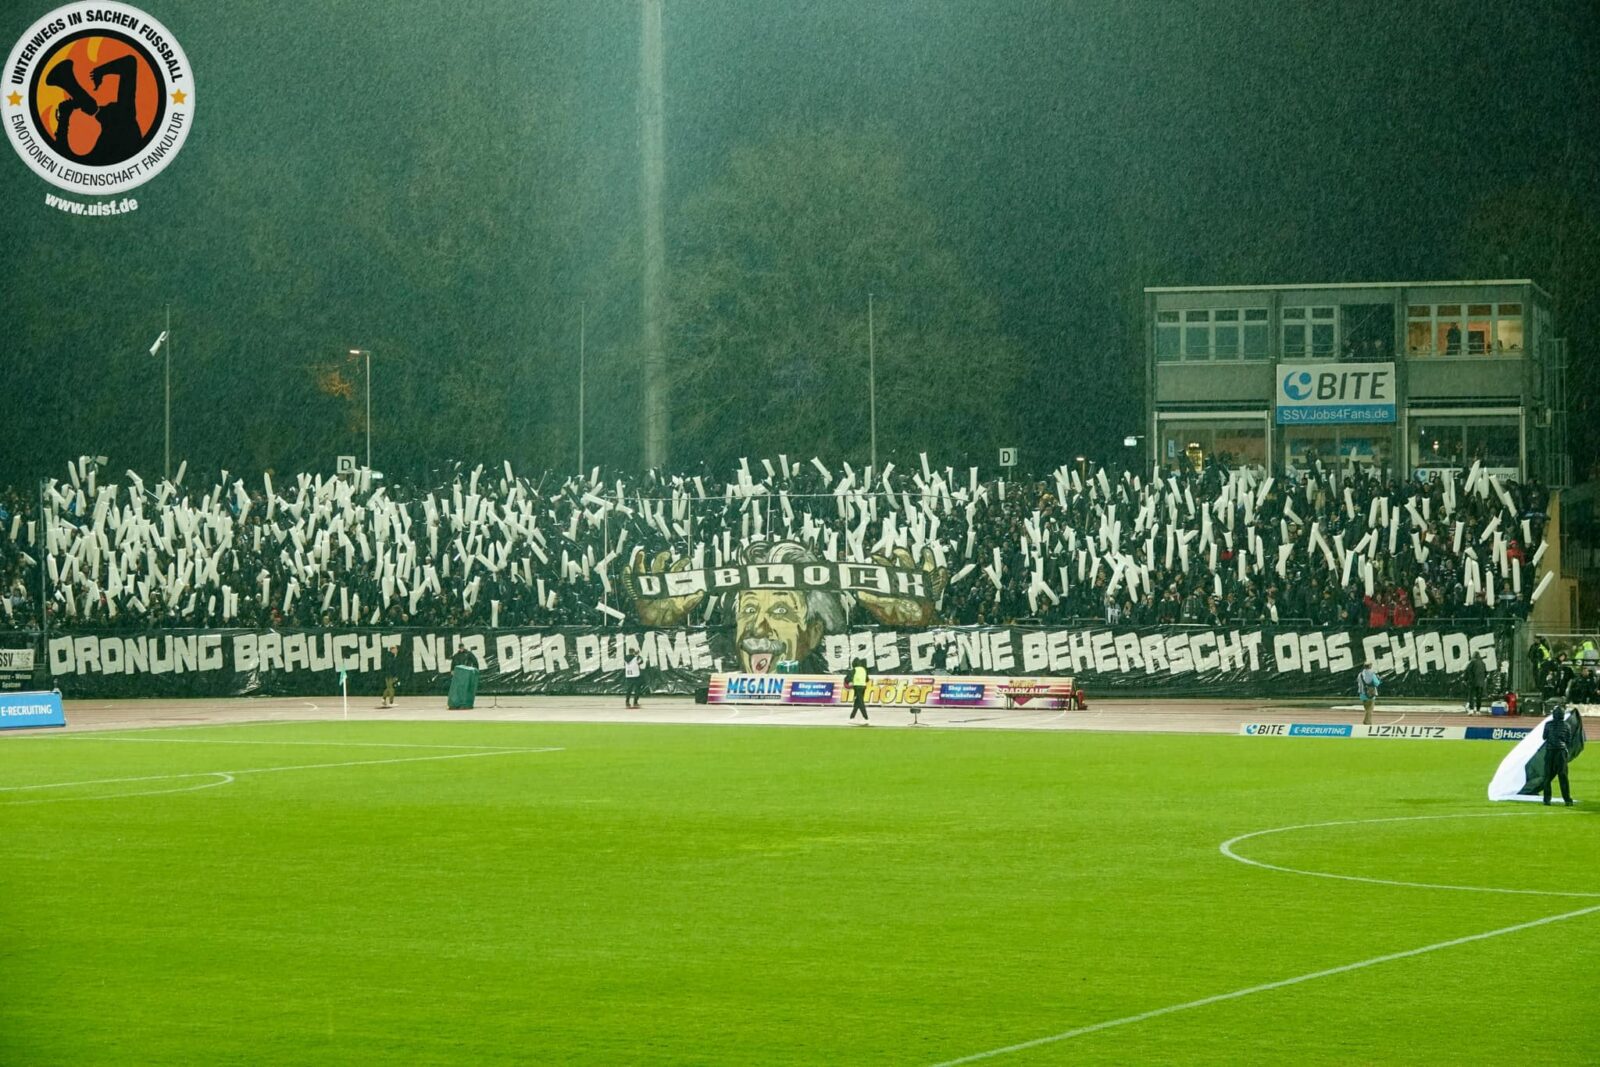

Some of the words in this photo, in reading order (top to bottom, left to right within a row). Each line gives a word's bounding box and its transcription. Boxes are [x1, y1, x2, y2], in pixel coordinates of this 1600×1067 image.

[1316, 371, 1389, 400] BITE
[1283, 408, 1389, 420] SSV.Jobs4Fans.de
[1002, 450, 1011, 464] D
[341, 458, 351, 471] D
[49, 633, 223, 675] ORDNUNG
[412, 633, 488, 673] NUR
[496, 632, 570, 674] DER
[823, 630, 900, 673] DAS
[1022, 630, 1262, 675] BEHERRSCHT
[1273, 631, 1353, 674] DAS
[1362, 631, 1498, 675] CHAOS
[1, 704, 53, 717] E-RECRUITING
[1258, 724, 1285, 735] BITE
[1294, 727, 1346, 735] E-RECRUITING
[1368, 725, 1407, 737] UZIN
[1411, 726, 1446, 738] UTZ
